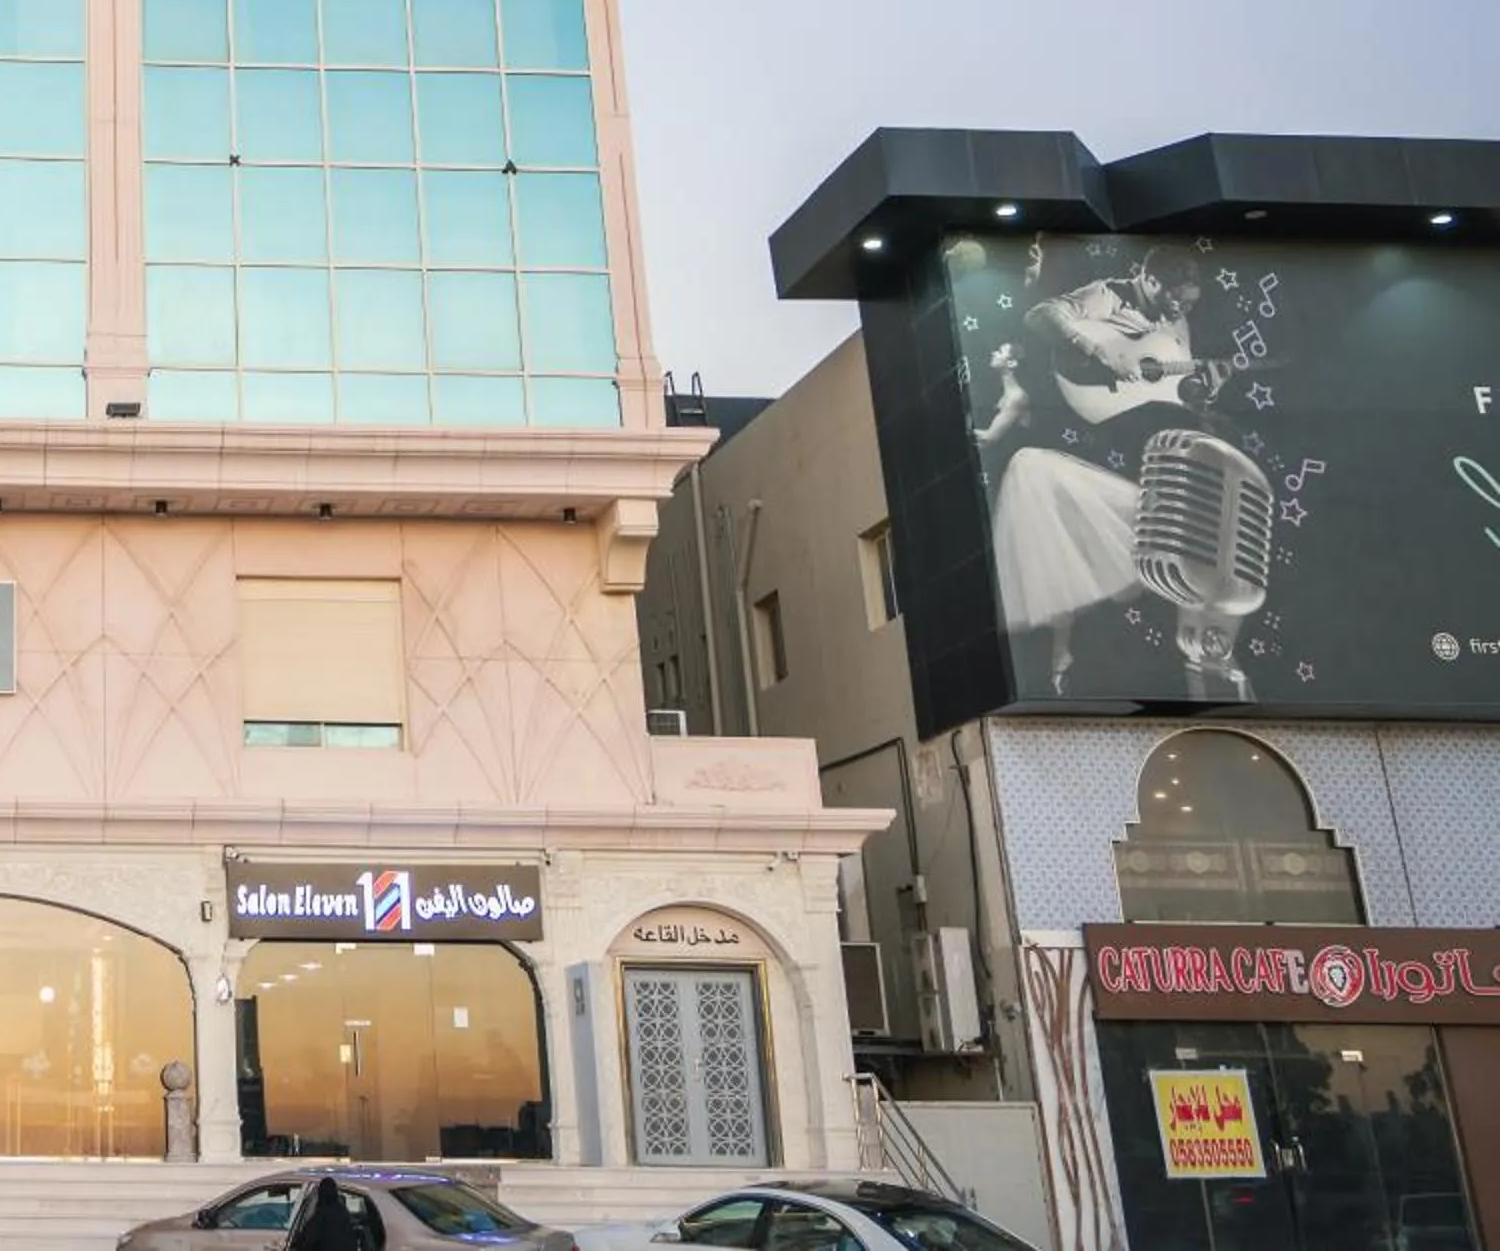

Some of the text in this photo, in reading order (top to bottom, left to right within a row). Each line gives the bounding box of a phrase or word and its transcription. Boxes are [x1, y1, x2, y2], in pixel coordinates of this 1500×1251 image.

[236, 883, 360, 917] Salon Eleven
[1098, 946, 1309, 995] CATURRA CAFE
